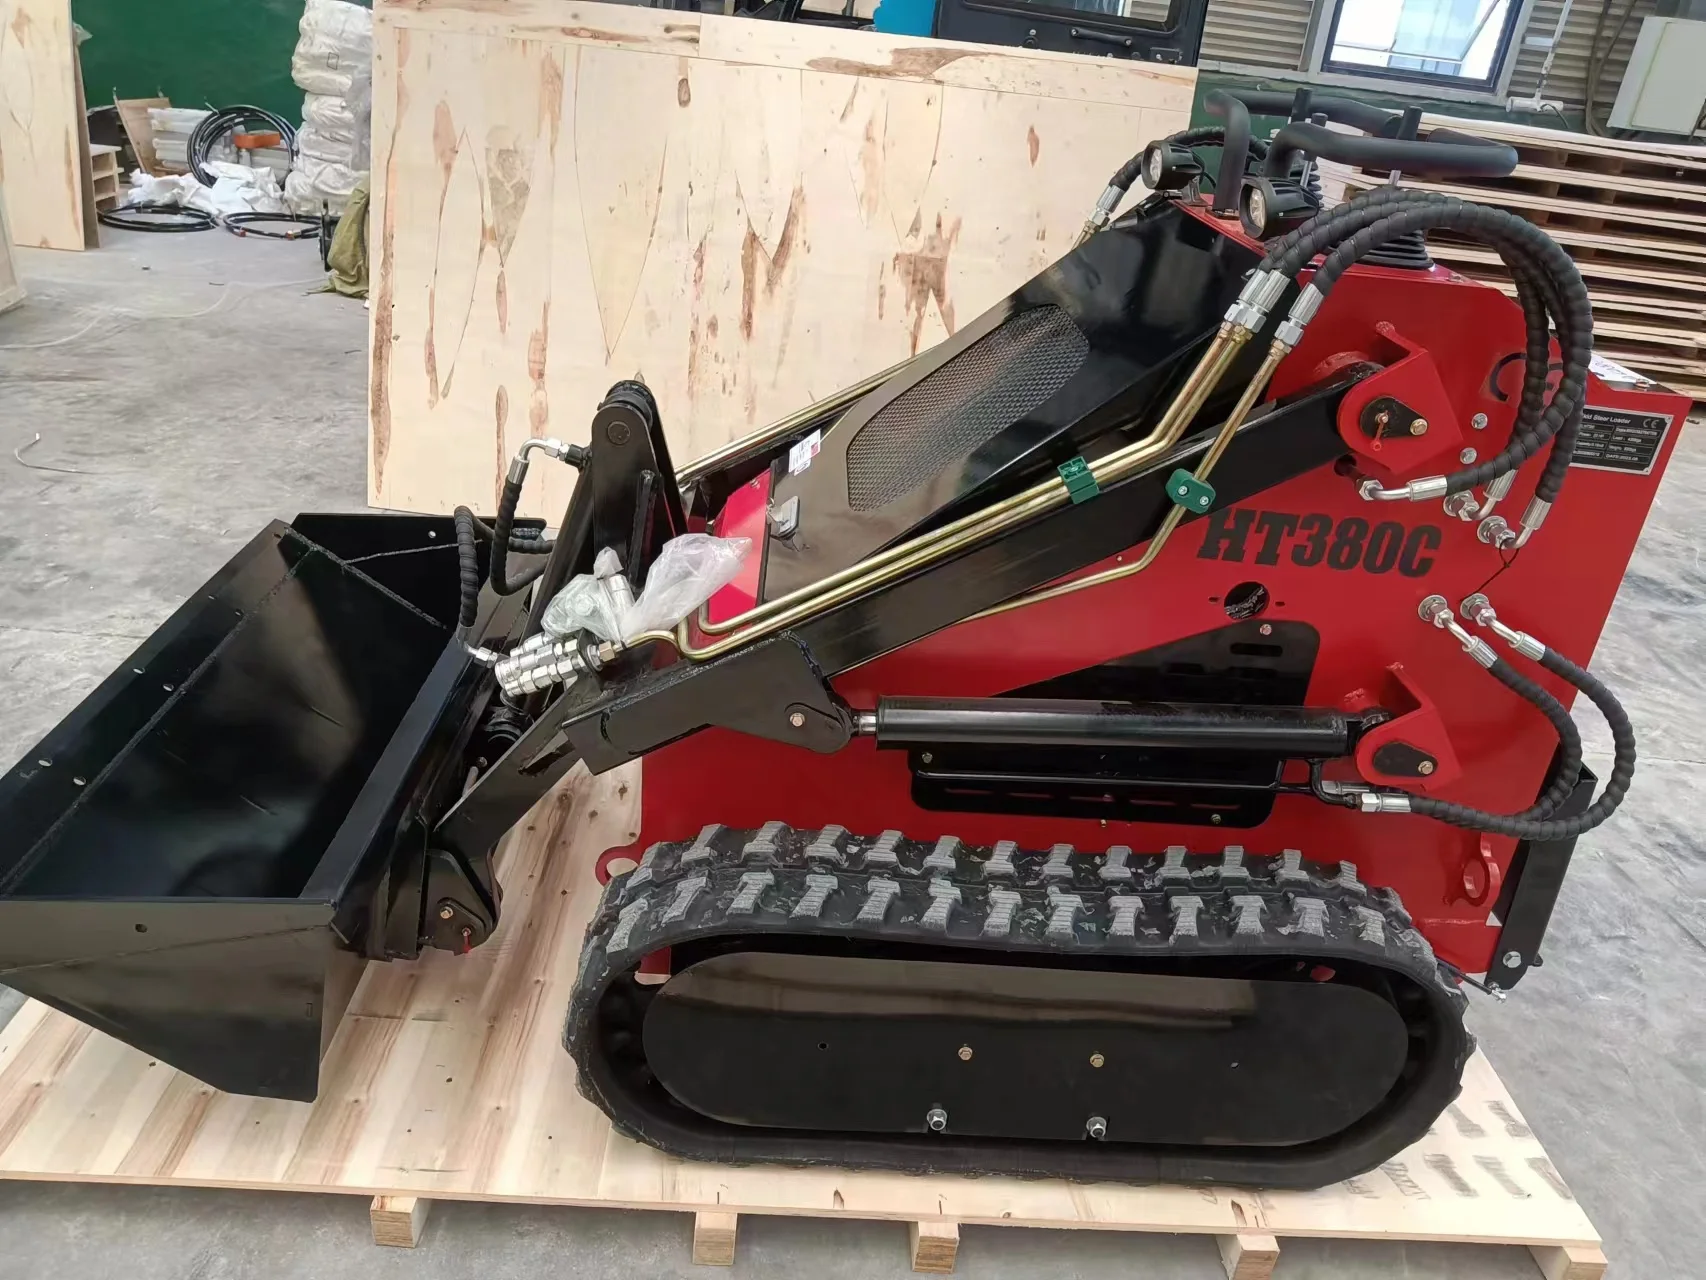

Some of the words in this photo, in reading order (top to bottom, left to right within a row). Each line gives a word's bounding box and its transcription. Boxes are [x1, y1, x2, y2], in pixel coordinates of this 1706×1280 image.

[1610, 416, 1631, 425] Loader
[1643, 418, 1660, 429] CE
[1197, 507, 1442, 578] HT380C
